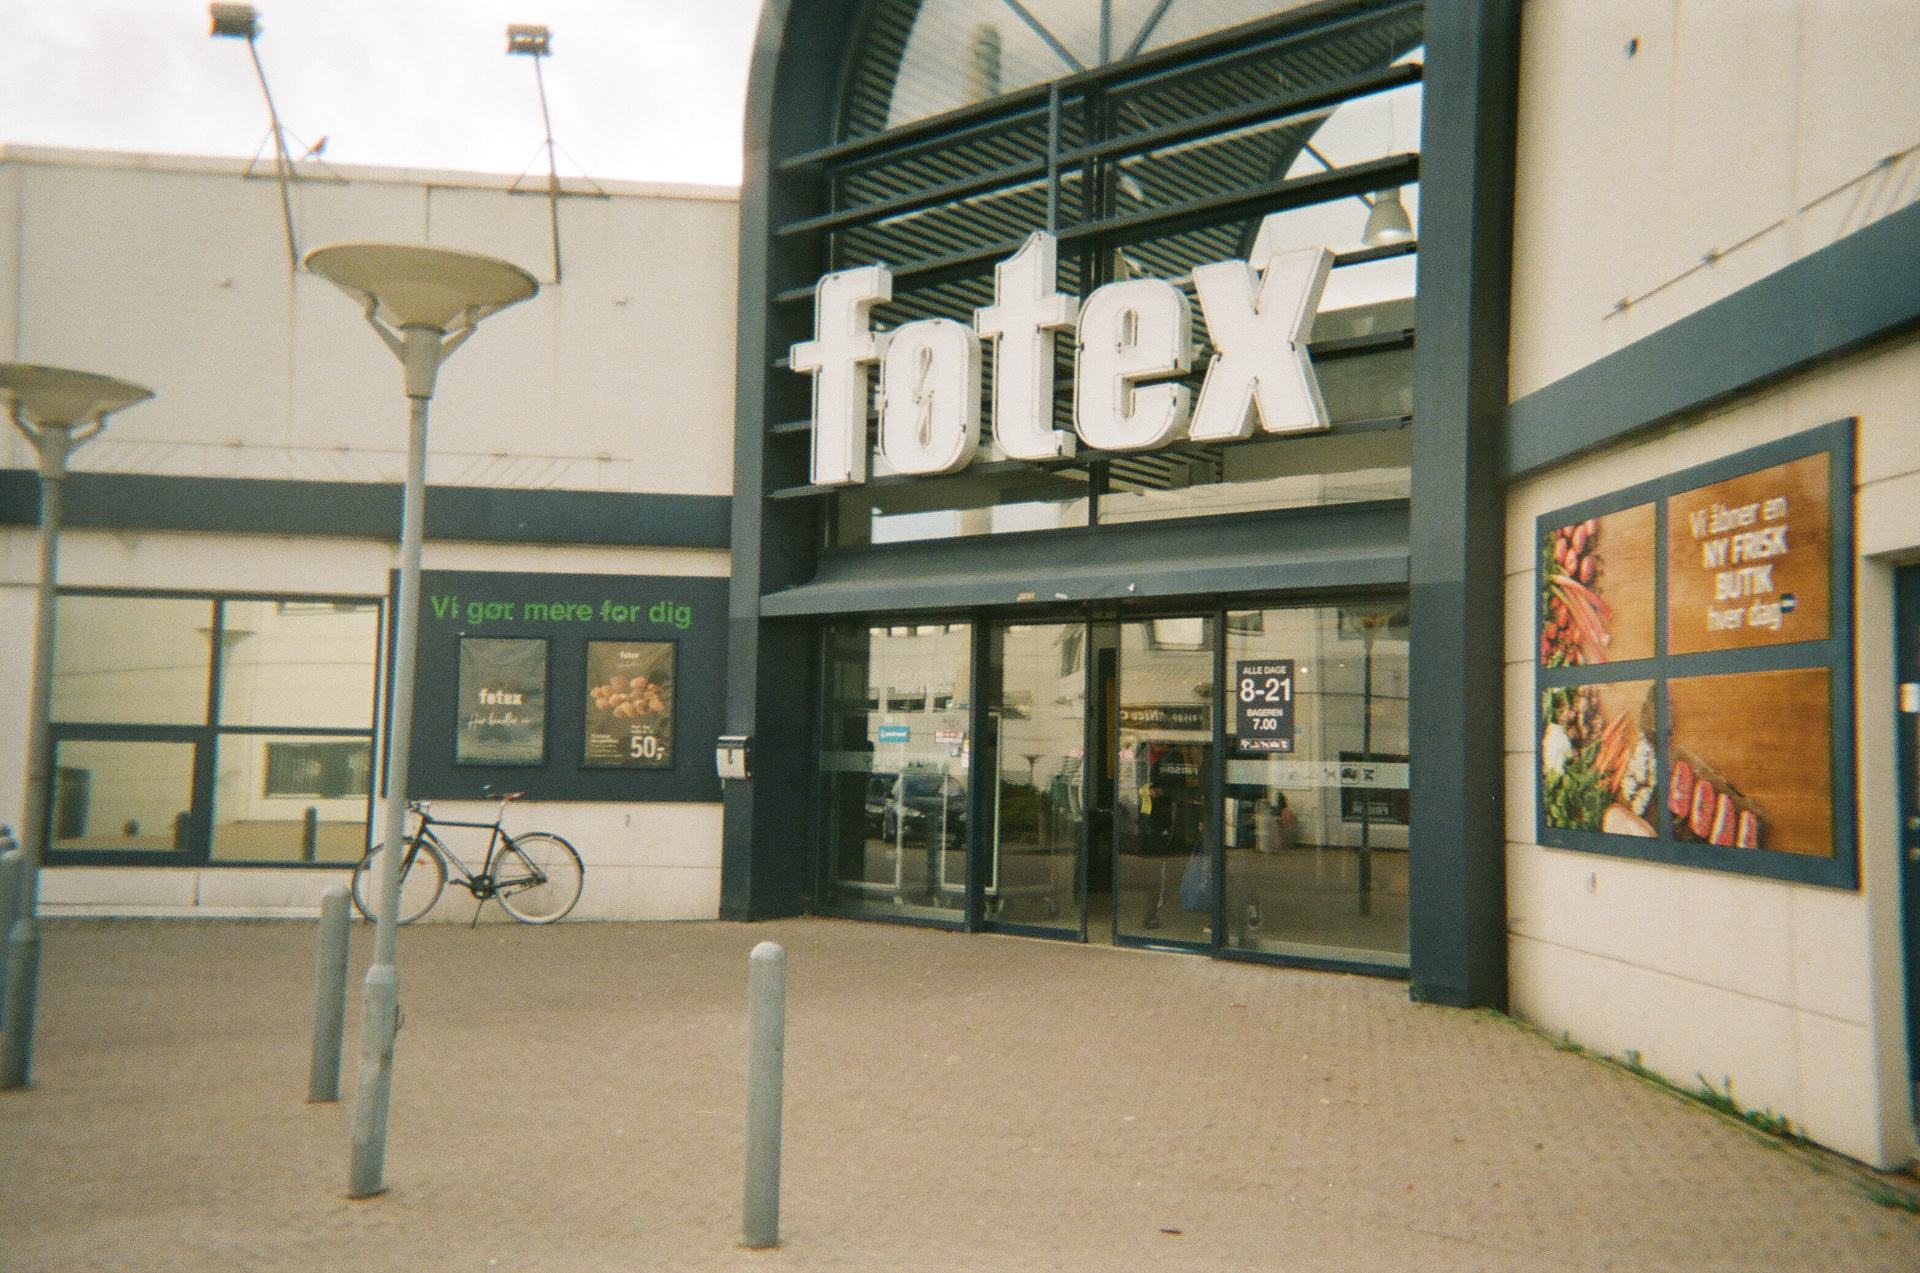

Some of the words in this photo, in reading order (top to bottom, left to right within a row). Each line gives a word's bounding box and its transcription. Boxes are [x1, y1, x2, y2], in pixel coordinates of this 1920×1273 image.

[788, 231, 1335, 485] føtex
[1690, 508, 1707, 539] Vi
[1709, 502, 1759, 533] åbner
[1762, 496, 1788, 521] en
[1702, 537, 1729, 569] NY
[1731, 523, 1788, 564] FRISK
[1715, 564, 1774, 601] BUTIK
[430, 595, 458, 618] Vi
[466, 600, 515, 625] gør
[523, 602, 594, 622] mere
[601, 599, 641, 623] for
[649, 601, 692, 630] dig
[1707, 605, 1746, 632] hver
[1748, 598, 1783, 631] dag
[1243, 666, 1263, 675] ALLE
[1264, 665, 1287, 675] DAGE
[1240, 677, 1291, 702] 8-21
[1252, 718, 1278, 731] 7.00
